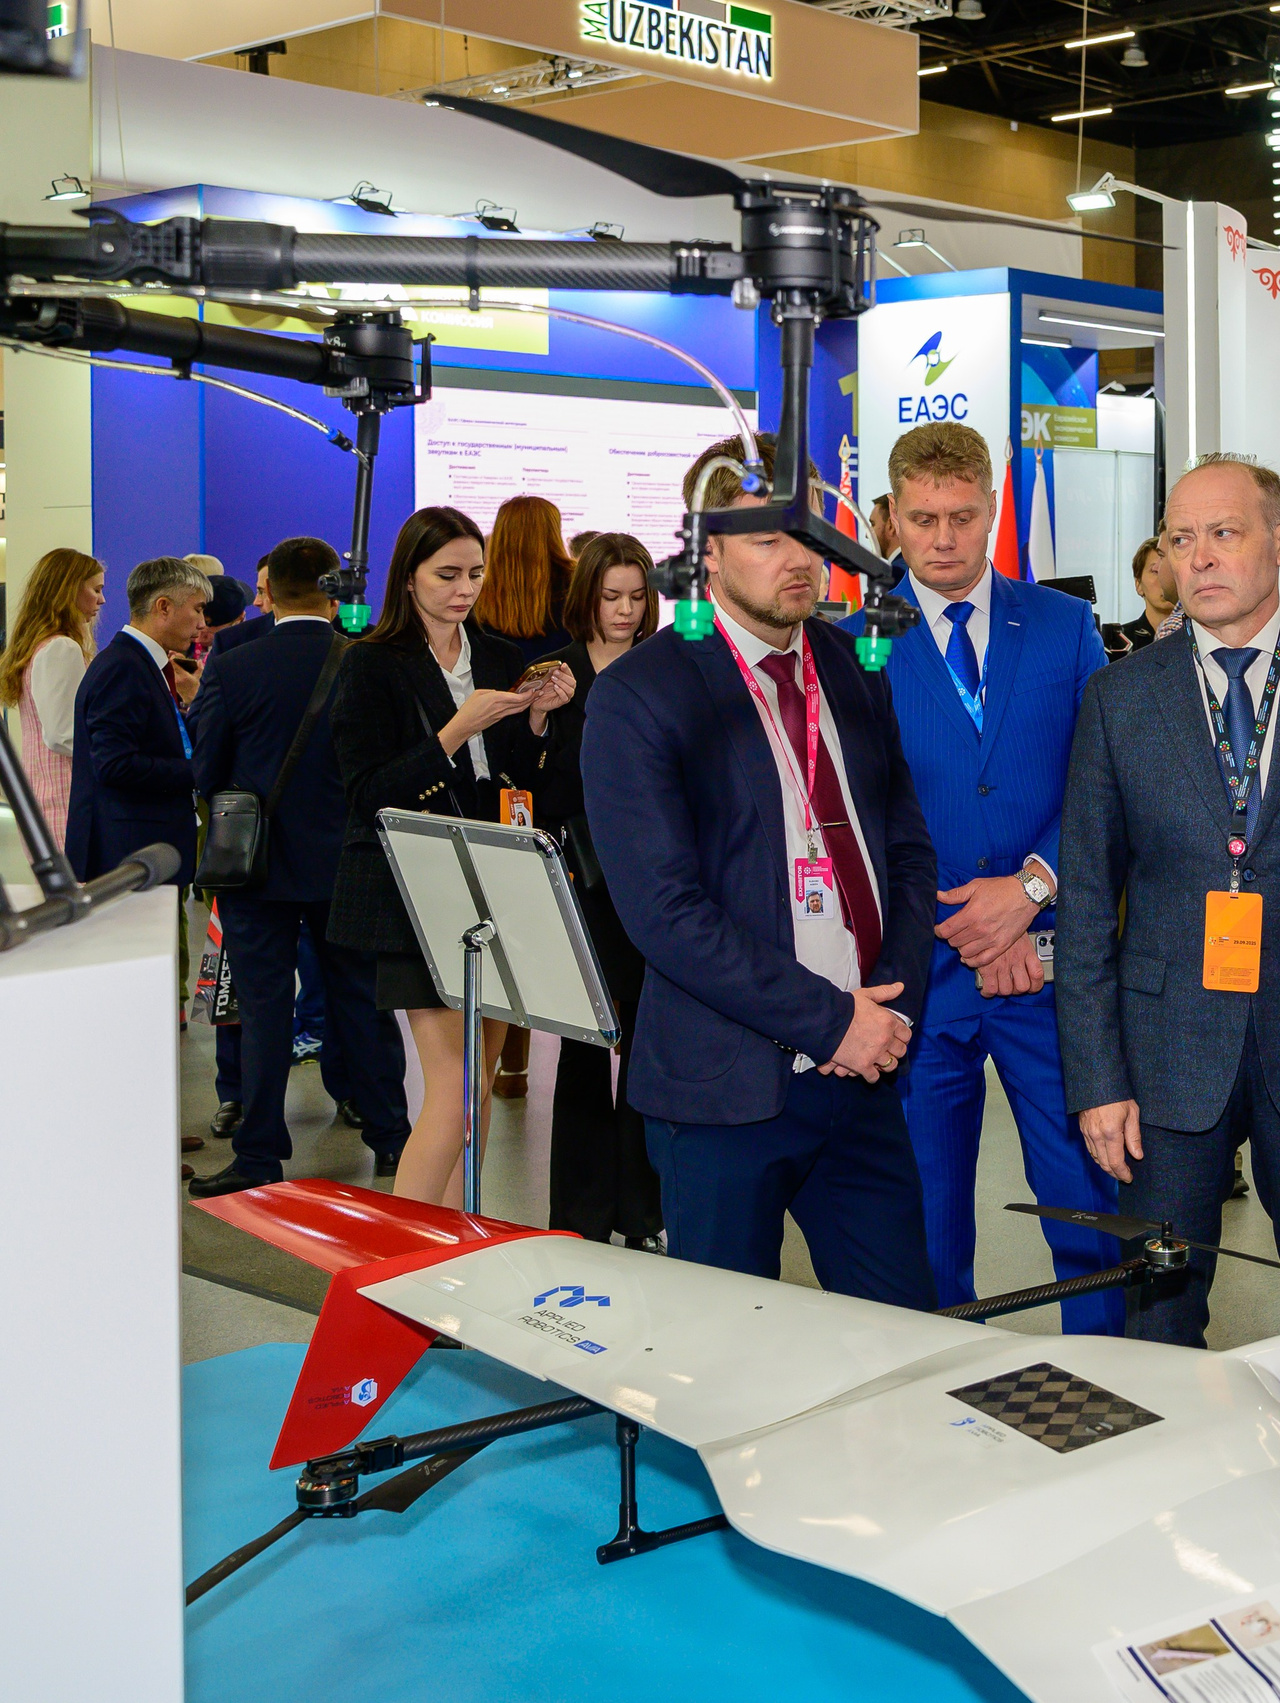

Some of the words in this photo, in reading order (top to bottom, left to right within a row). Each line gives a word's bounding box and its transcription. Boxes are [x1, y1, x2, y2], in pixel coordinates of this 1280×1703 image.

[609, 0, 772, 77] UZBEKISTAN
[898, 393, 968, 423] ЕАЭС
[216, 949, 231, 1017] ГОМСЕ
[518, 1315, 581, 1344] ROBOTICS
[534, 1309, 586, 1332] APPLIED
